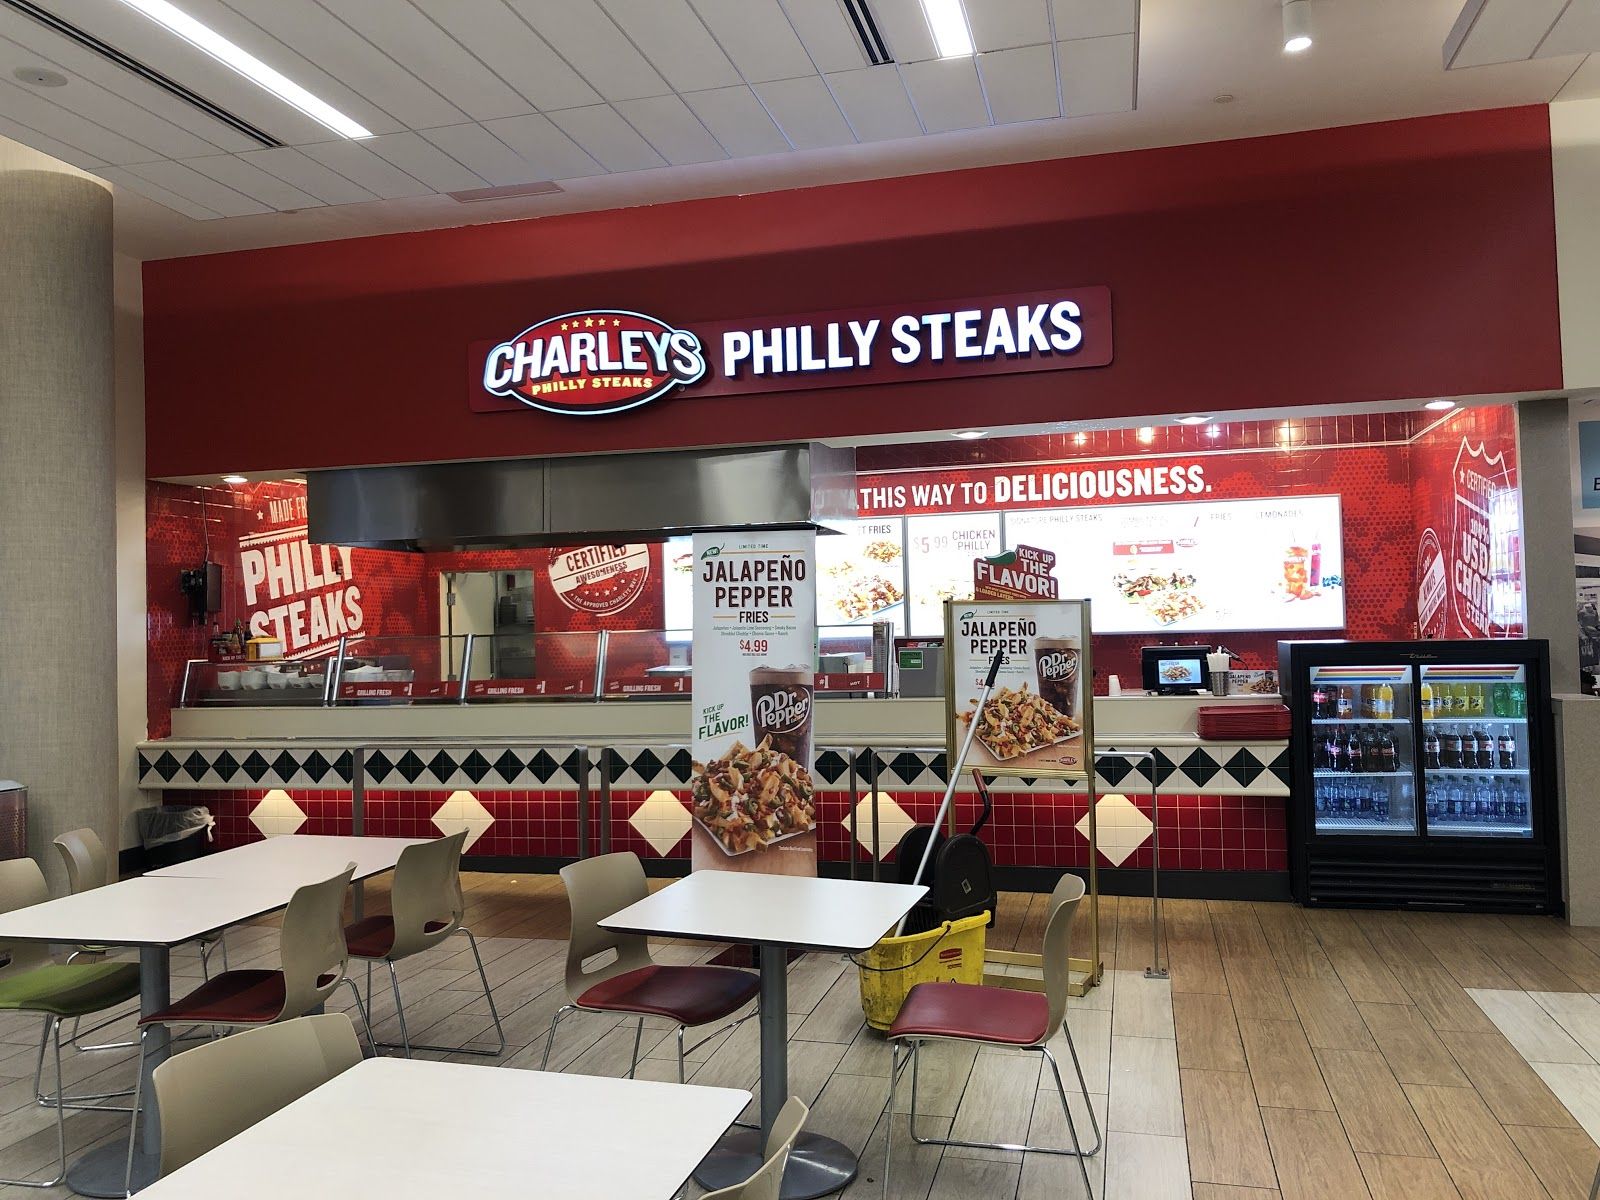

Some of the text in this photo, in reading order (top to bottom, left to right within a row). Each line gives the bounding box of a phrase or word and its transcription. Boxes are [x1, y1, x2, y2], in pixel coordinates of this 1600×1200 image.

[723, 301, 1082, 377] PHILLY STEAKS
[486, 331, 701, 389] CHARLEYS
[532, 377, 653, 396] PHILLY STEAKS
[860, 487, 906, 510] THIS
[912, 484, 954, 506] WAY
[961, 482, 987, 505] TO
[994, 465, 1213, 502] DELICIOUSNESS.
[1467, 469, 1496, 499] CERTIFIED
[269, 498, 294, 523] MADE
[869, 525, 891, 534] FRIES
[952, 530, 995, 541] CHICKEN
[958, 540, 990, 551] PHILLY
[1018, 548, 1054, 564] KICK UP
[566, 545, 627, 571] CERTIFIED
[703, 554, 806, 582] JALAPEÑO
[1020, 558, 1048, 577] THE
[241, 541, 353, 606] PHILLY
[576, 561, 628, 584] AWESOMENESS
[977, 562, 1056, 599] FLAVOR!
[715, 586, 793, 608] PEPPER
[1456, 559, 1488, 614] CHOI
[250, 586, 363, 653] STEAKS
[739, 611, 769, 623] FRIES
[961, 618, 1037, 636] JALAPEÑO
[739, 639, 768, 652] $4.99
[970, 639, 1027, 654] PEPPER
[1039, 656, 1076, 678] Pepper
[1051, 652, 1067, 665] Dr
[819, 675, 829, 688] #1
[703, 703, 725, 714] KICK UP
[774, 690, 797, 711] Dr
[704, 712, 721, 725] THE
[757, 695, 809, 729] Pepper
[698, 714, 749, 740] FLAVOR!
